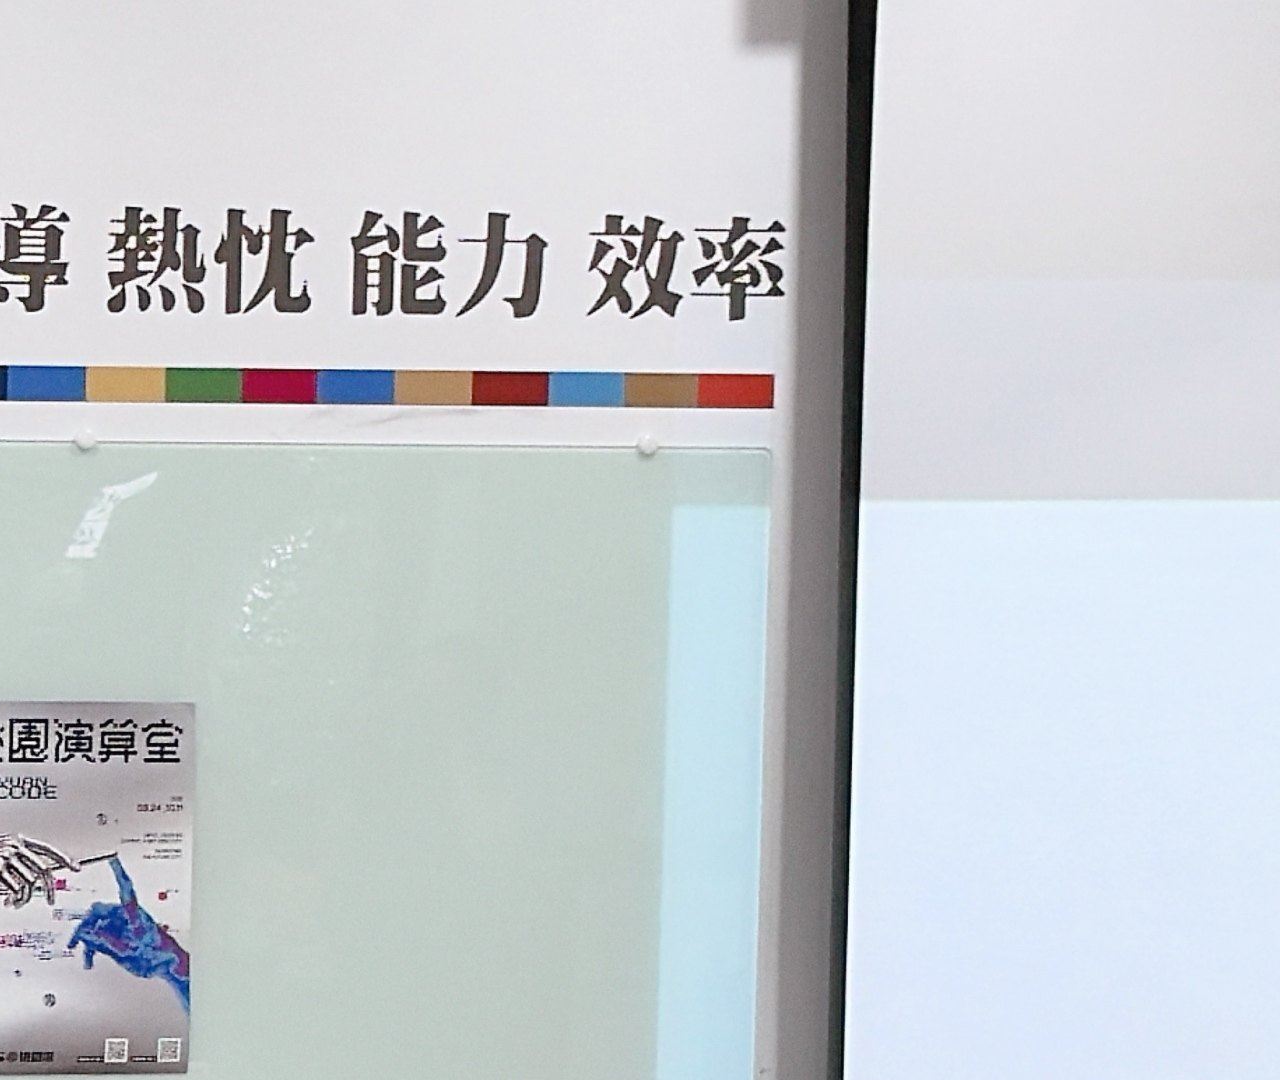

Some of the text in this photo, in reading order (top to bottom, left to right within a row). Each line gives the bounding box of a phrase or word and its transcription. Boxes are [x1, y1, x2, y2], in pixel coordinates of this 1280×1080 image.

[108, 207, 314, 314] 熱忱
[351, 211, 547, 318] 能力
[588, 215, 785, 320] 效率
